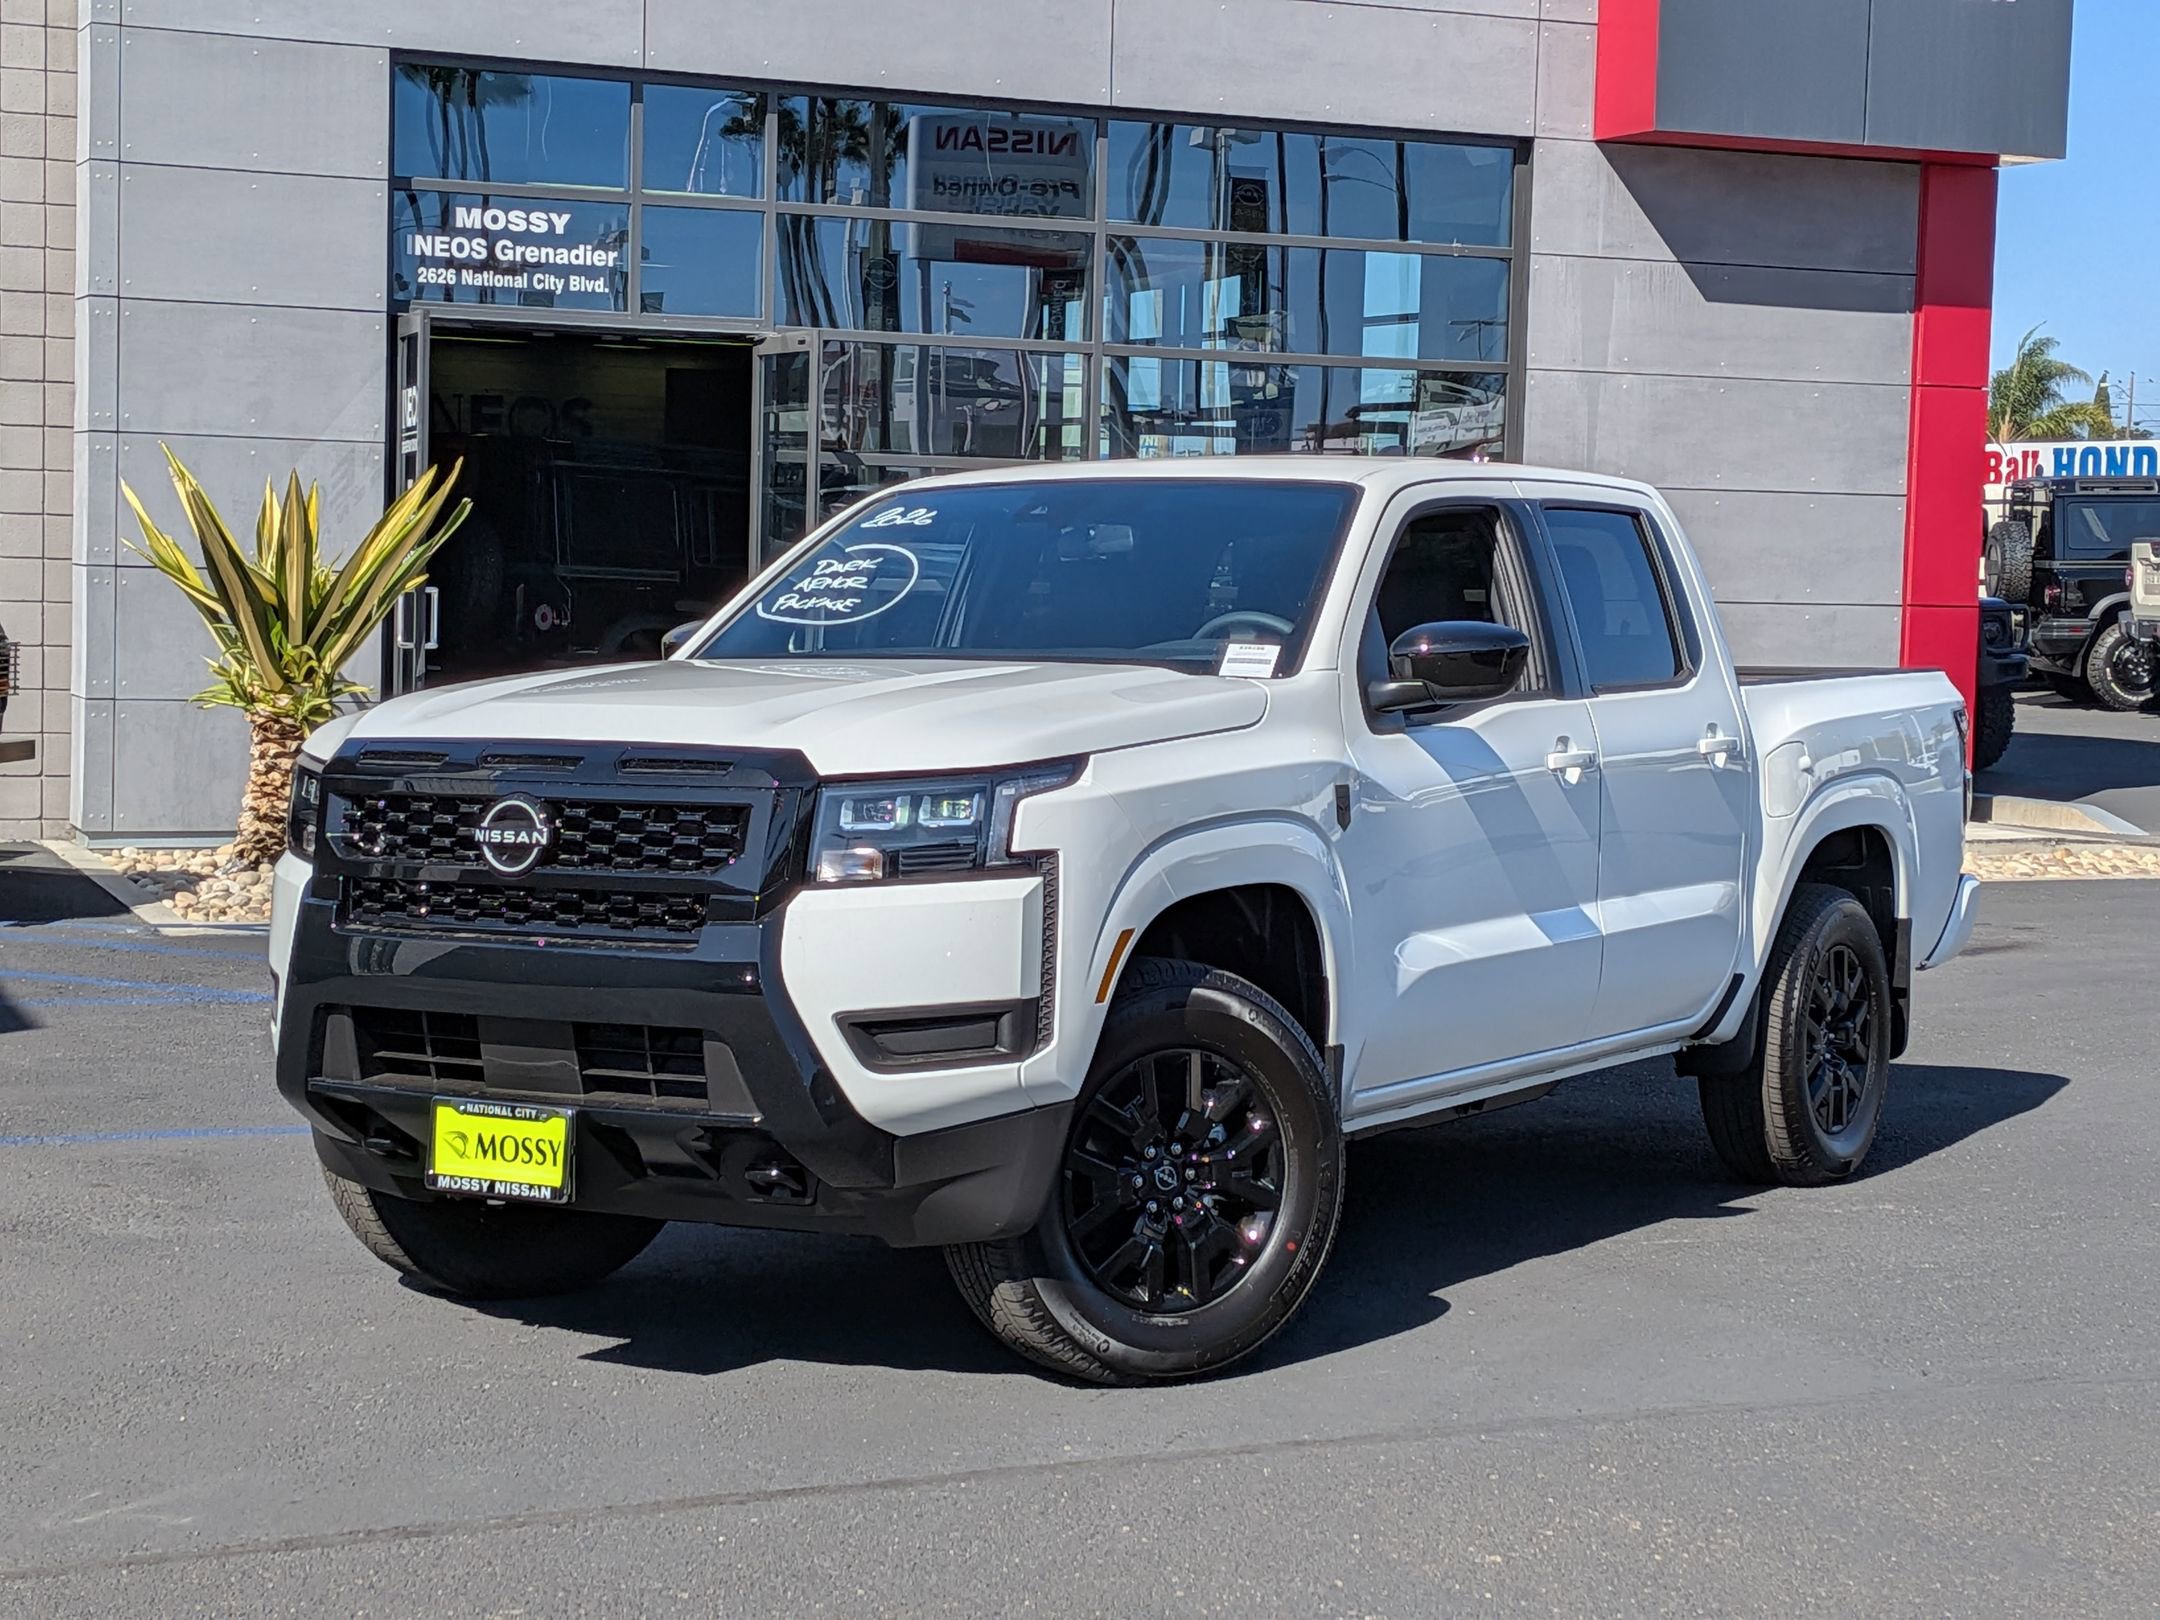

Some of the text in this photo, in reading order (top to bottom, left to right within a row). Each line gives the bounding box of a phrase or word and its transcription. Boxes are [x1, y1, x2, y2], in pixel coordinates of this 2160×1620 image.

[455, 207, 571, 235] MOSSY
[406, 234, 618, 267] INEOS Grenadier
[417, 267, 609, 295] 2626 National City Blvd.
[860, 507, 938, 529] 2026
[813, 557, 884, 576] DARK
[771, 593, 863, 613] PACKAGE
[473, 828, 548, 845] NISSAN
[466, 1103, 538, 1119] NATIONAL CITY
[475, 1132, 562, 1167] MOSSY
[437, 1175, 552, 1199] MOSSY NISSAN
